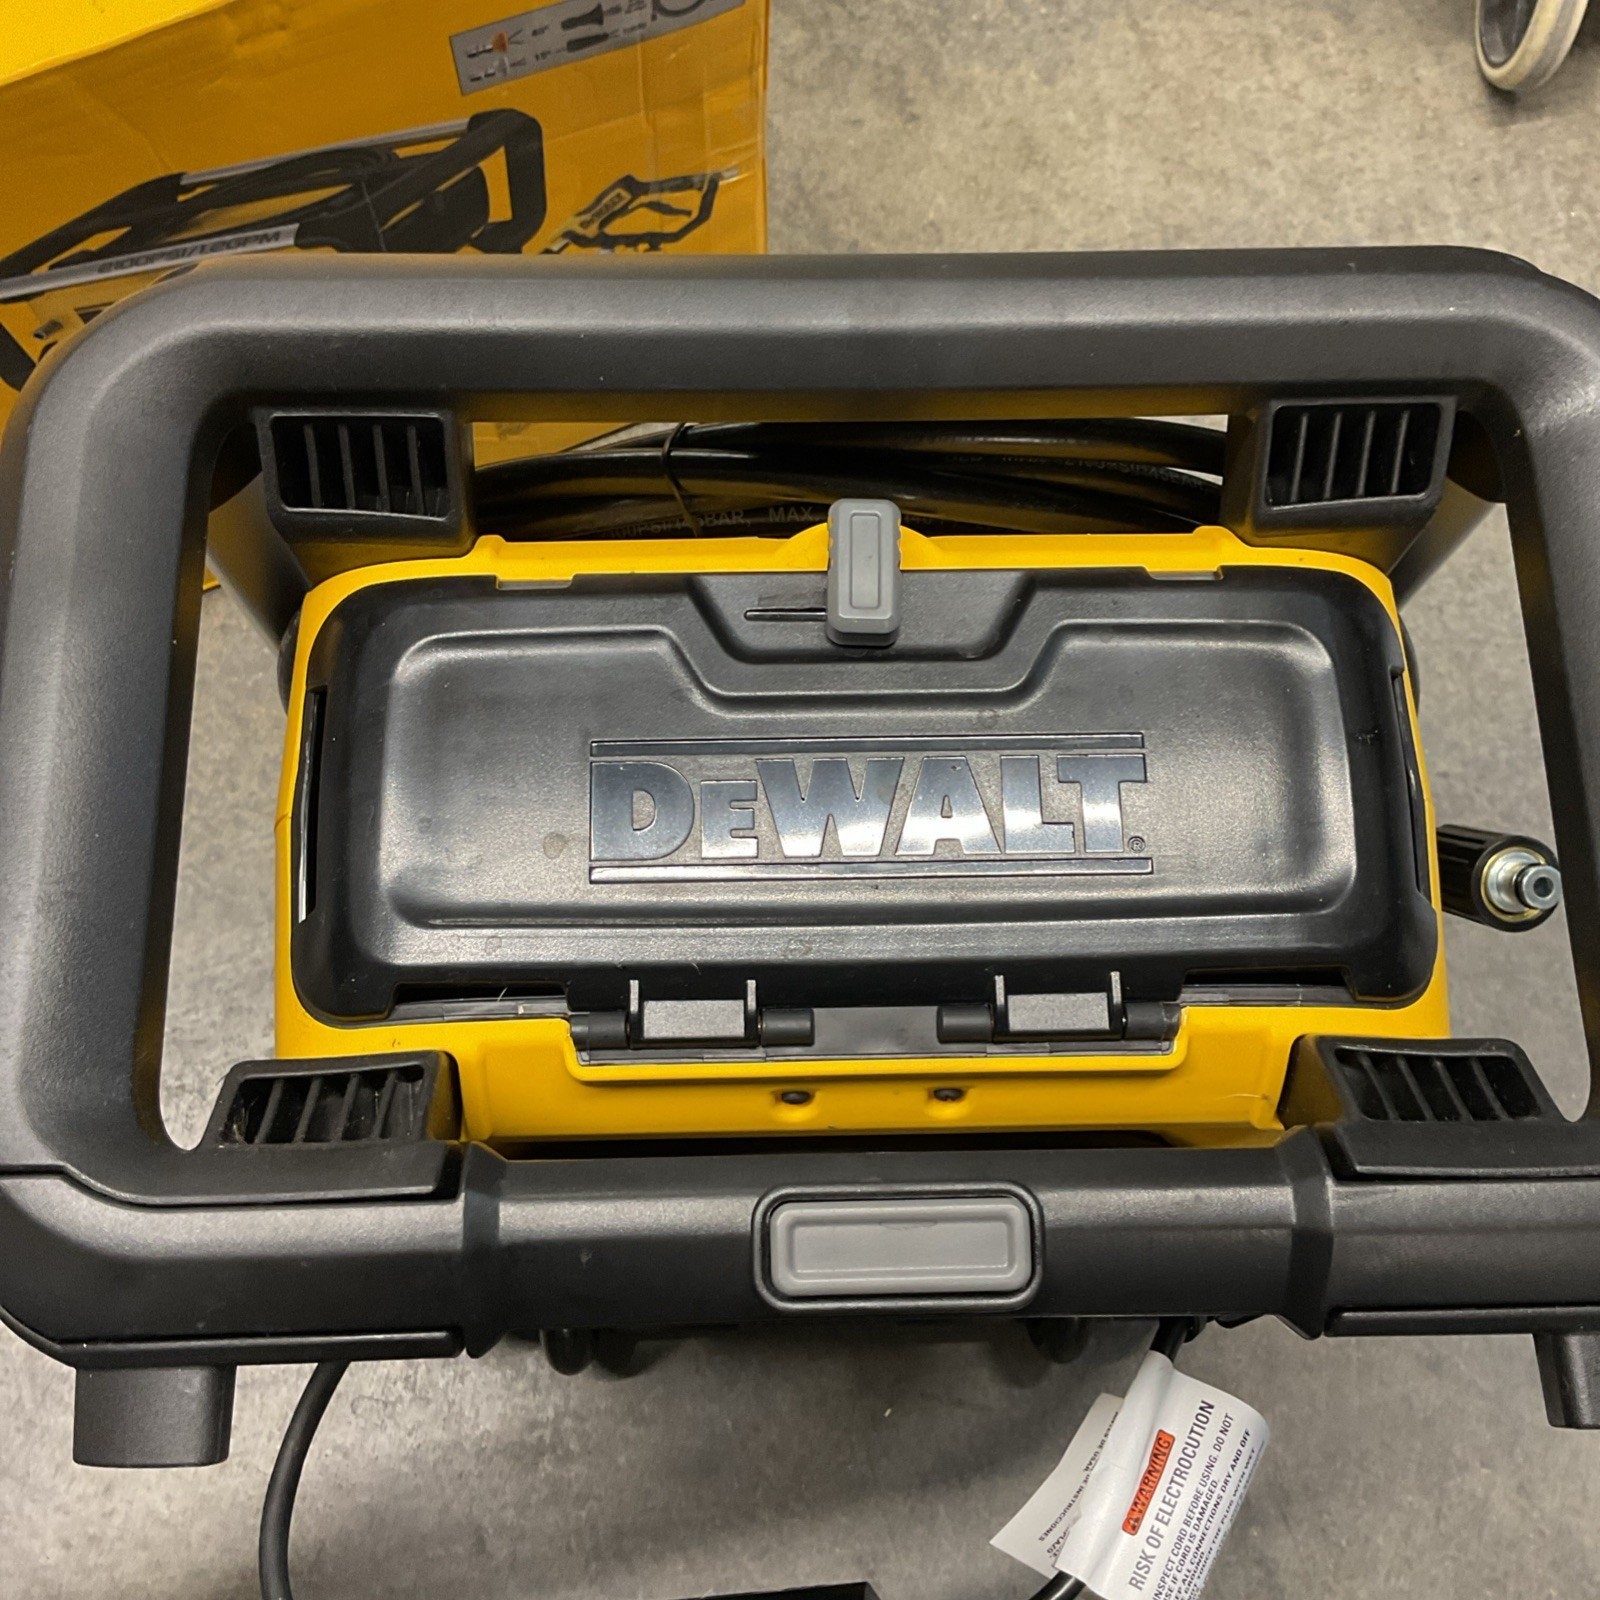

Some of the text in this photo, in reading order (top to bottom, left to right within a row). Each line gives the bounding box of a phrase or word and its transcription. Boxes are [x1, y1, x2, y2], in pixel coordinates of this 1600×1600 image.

[1212, 1435, 1225, 1452] DO
[1218, 1412, 1234, 1436] NOT
[1129, 1436, 1171, 1516] WARNING
[1198, 1452, 1218, 1488] USING.
[1127, 1399, 1216, 1591] RISK OF ELECTROCUTION
[1180, 1567, 1192, 1585] ALL
[1189, 1493, 1223, 1565] CONNECTIONS
[1220, 1471, 1232, 1492] DRY
[1229, 1448, 1243, 1471] AND
[1239, 1427, 1251, 1447] OFF
[1182, 1487, 1204, 1527] BEFORE
[1163, 1476, 1219, 1600] SE IF CORD IS DAMAGED.
[1170, 1527, 1188, 1557] CORD
